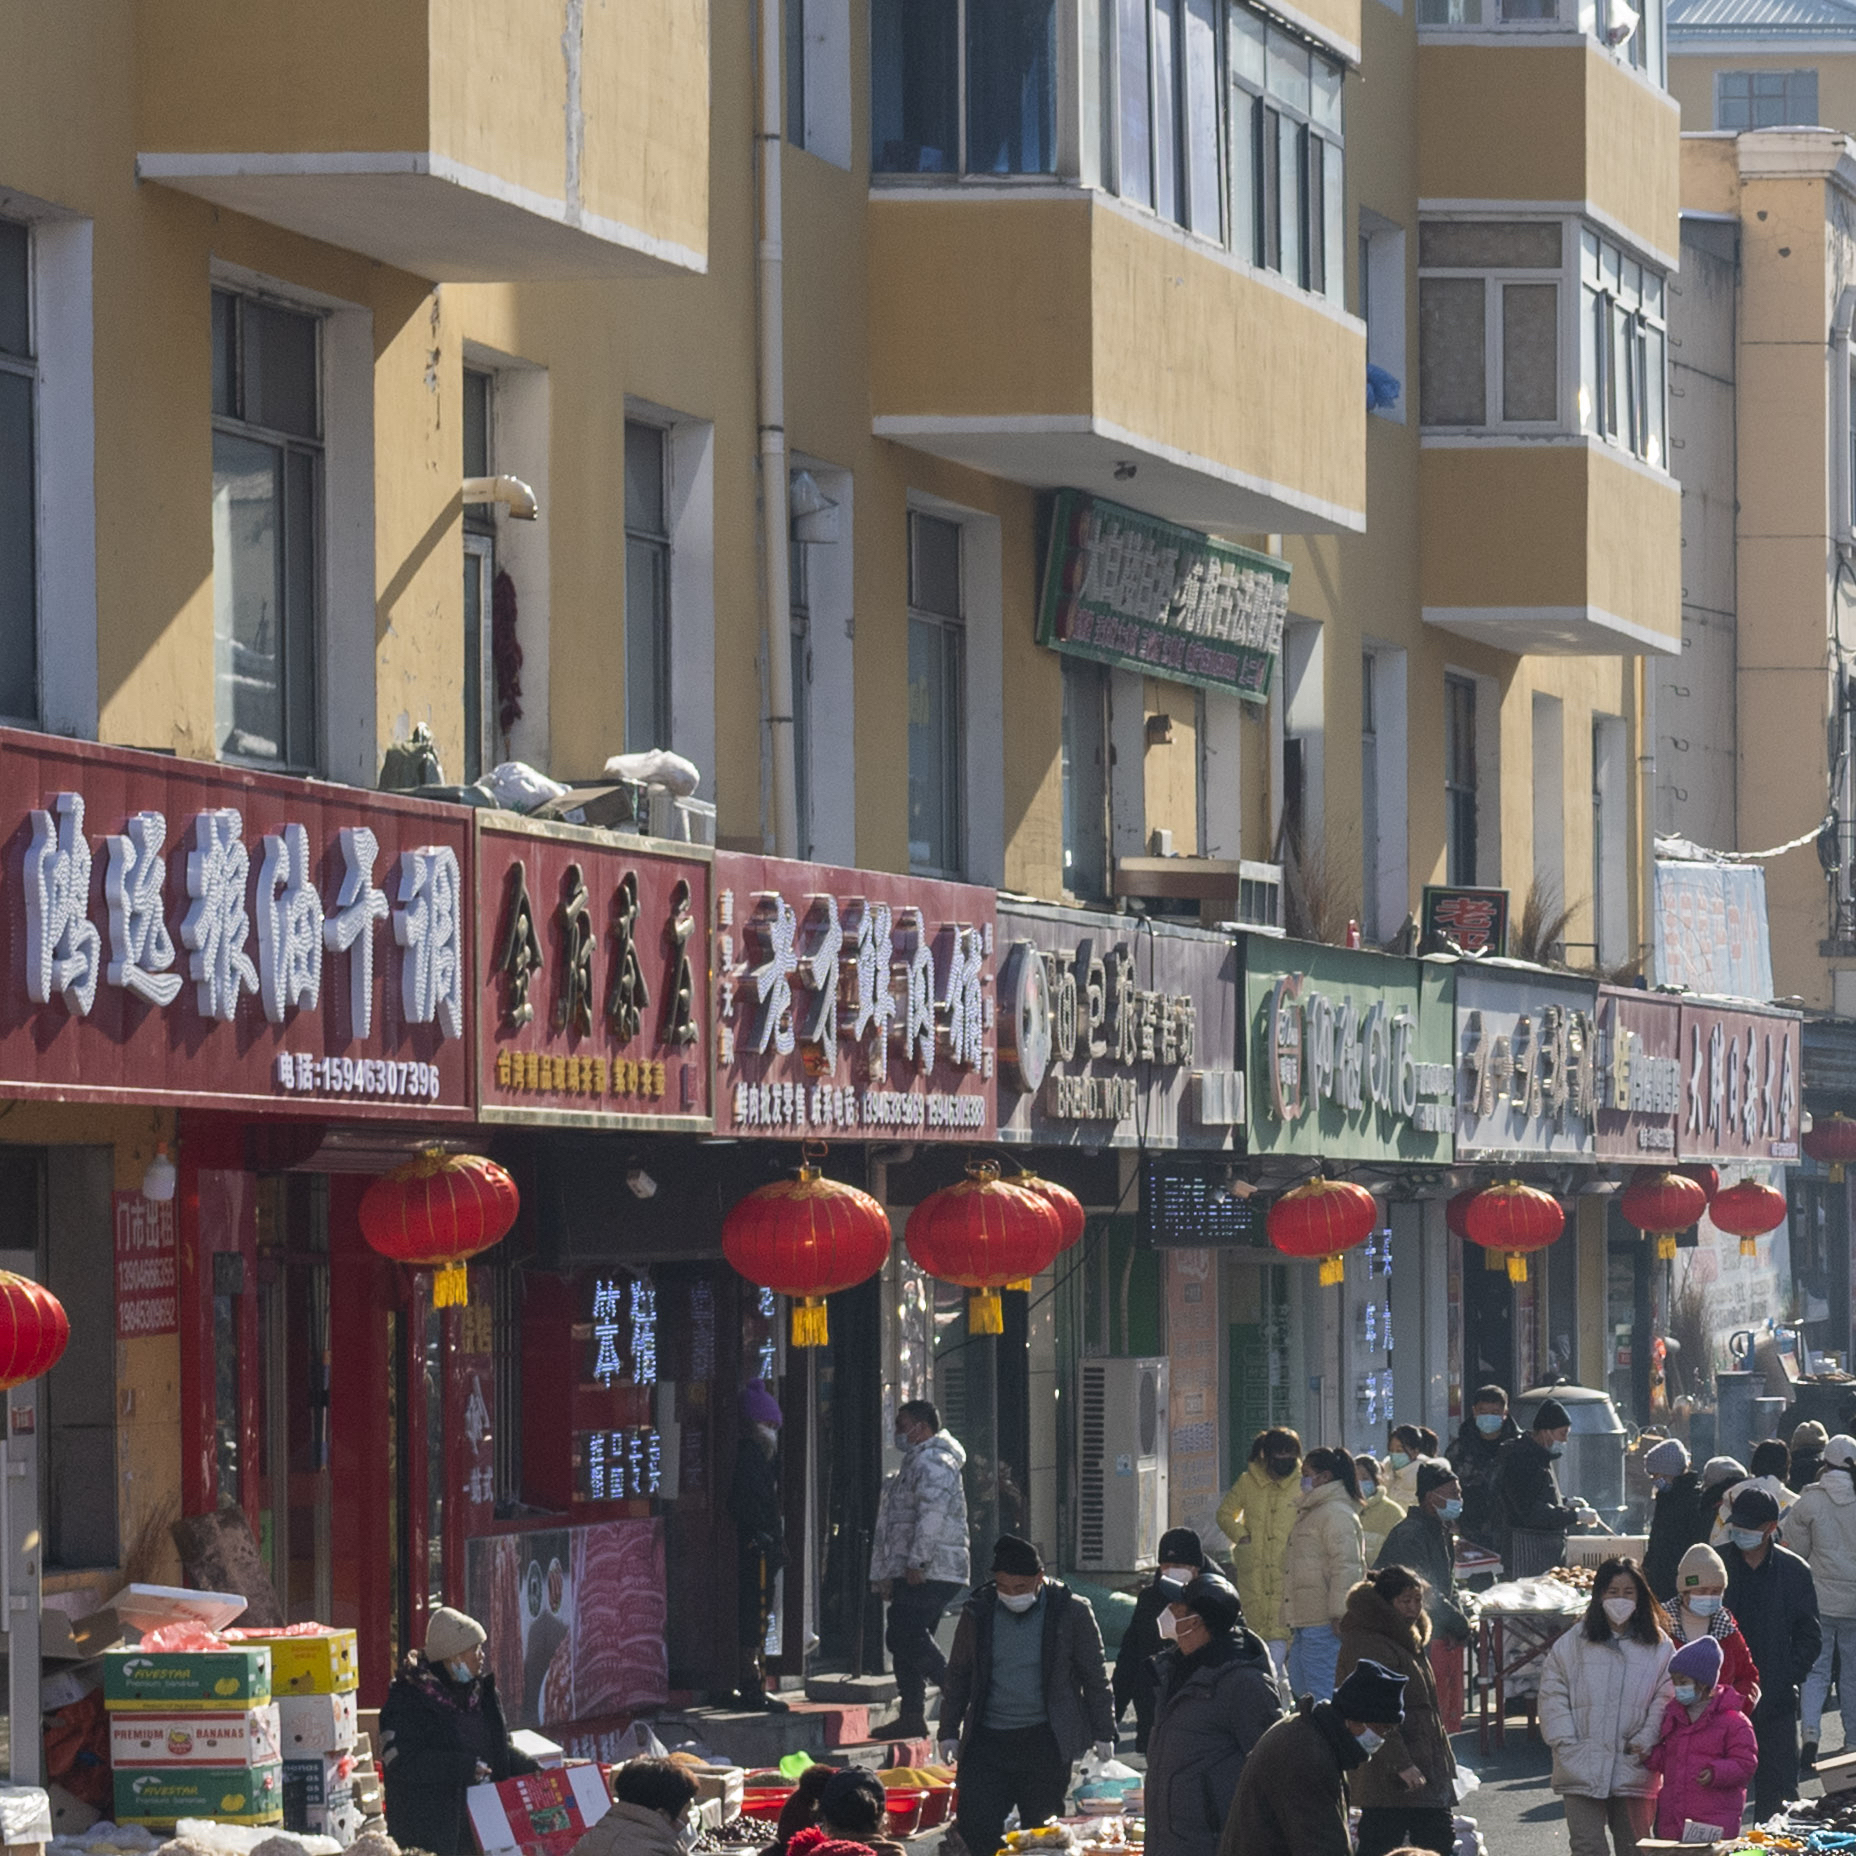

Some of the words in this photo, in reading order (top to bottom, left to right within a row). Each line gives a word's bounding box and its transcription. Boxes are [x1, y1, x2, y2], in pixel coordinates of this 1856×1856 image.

[278, 1052, 440, 1099] 电话:15946307396
[113, 1729, 164, 1740] PREMIUM
[196, 1728, 244, 1739] BANANAS
